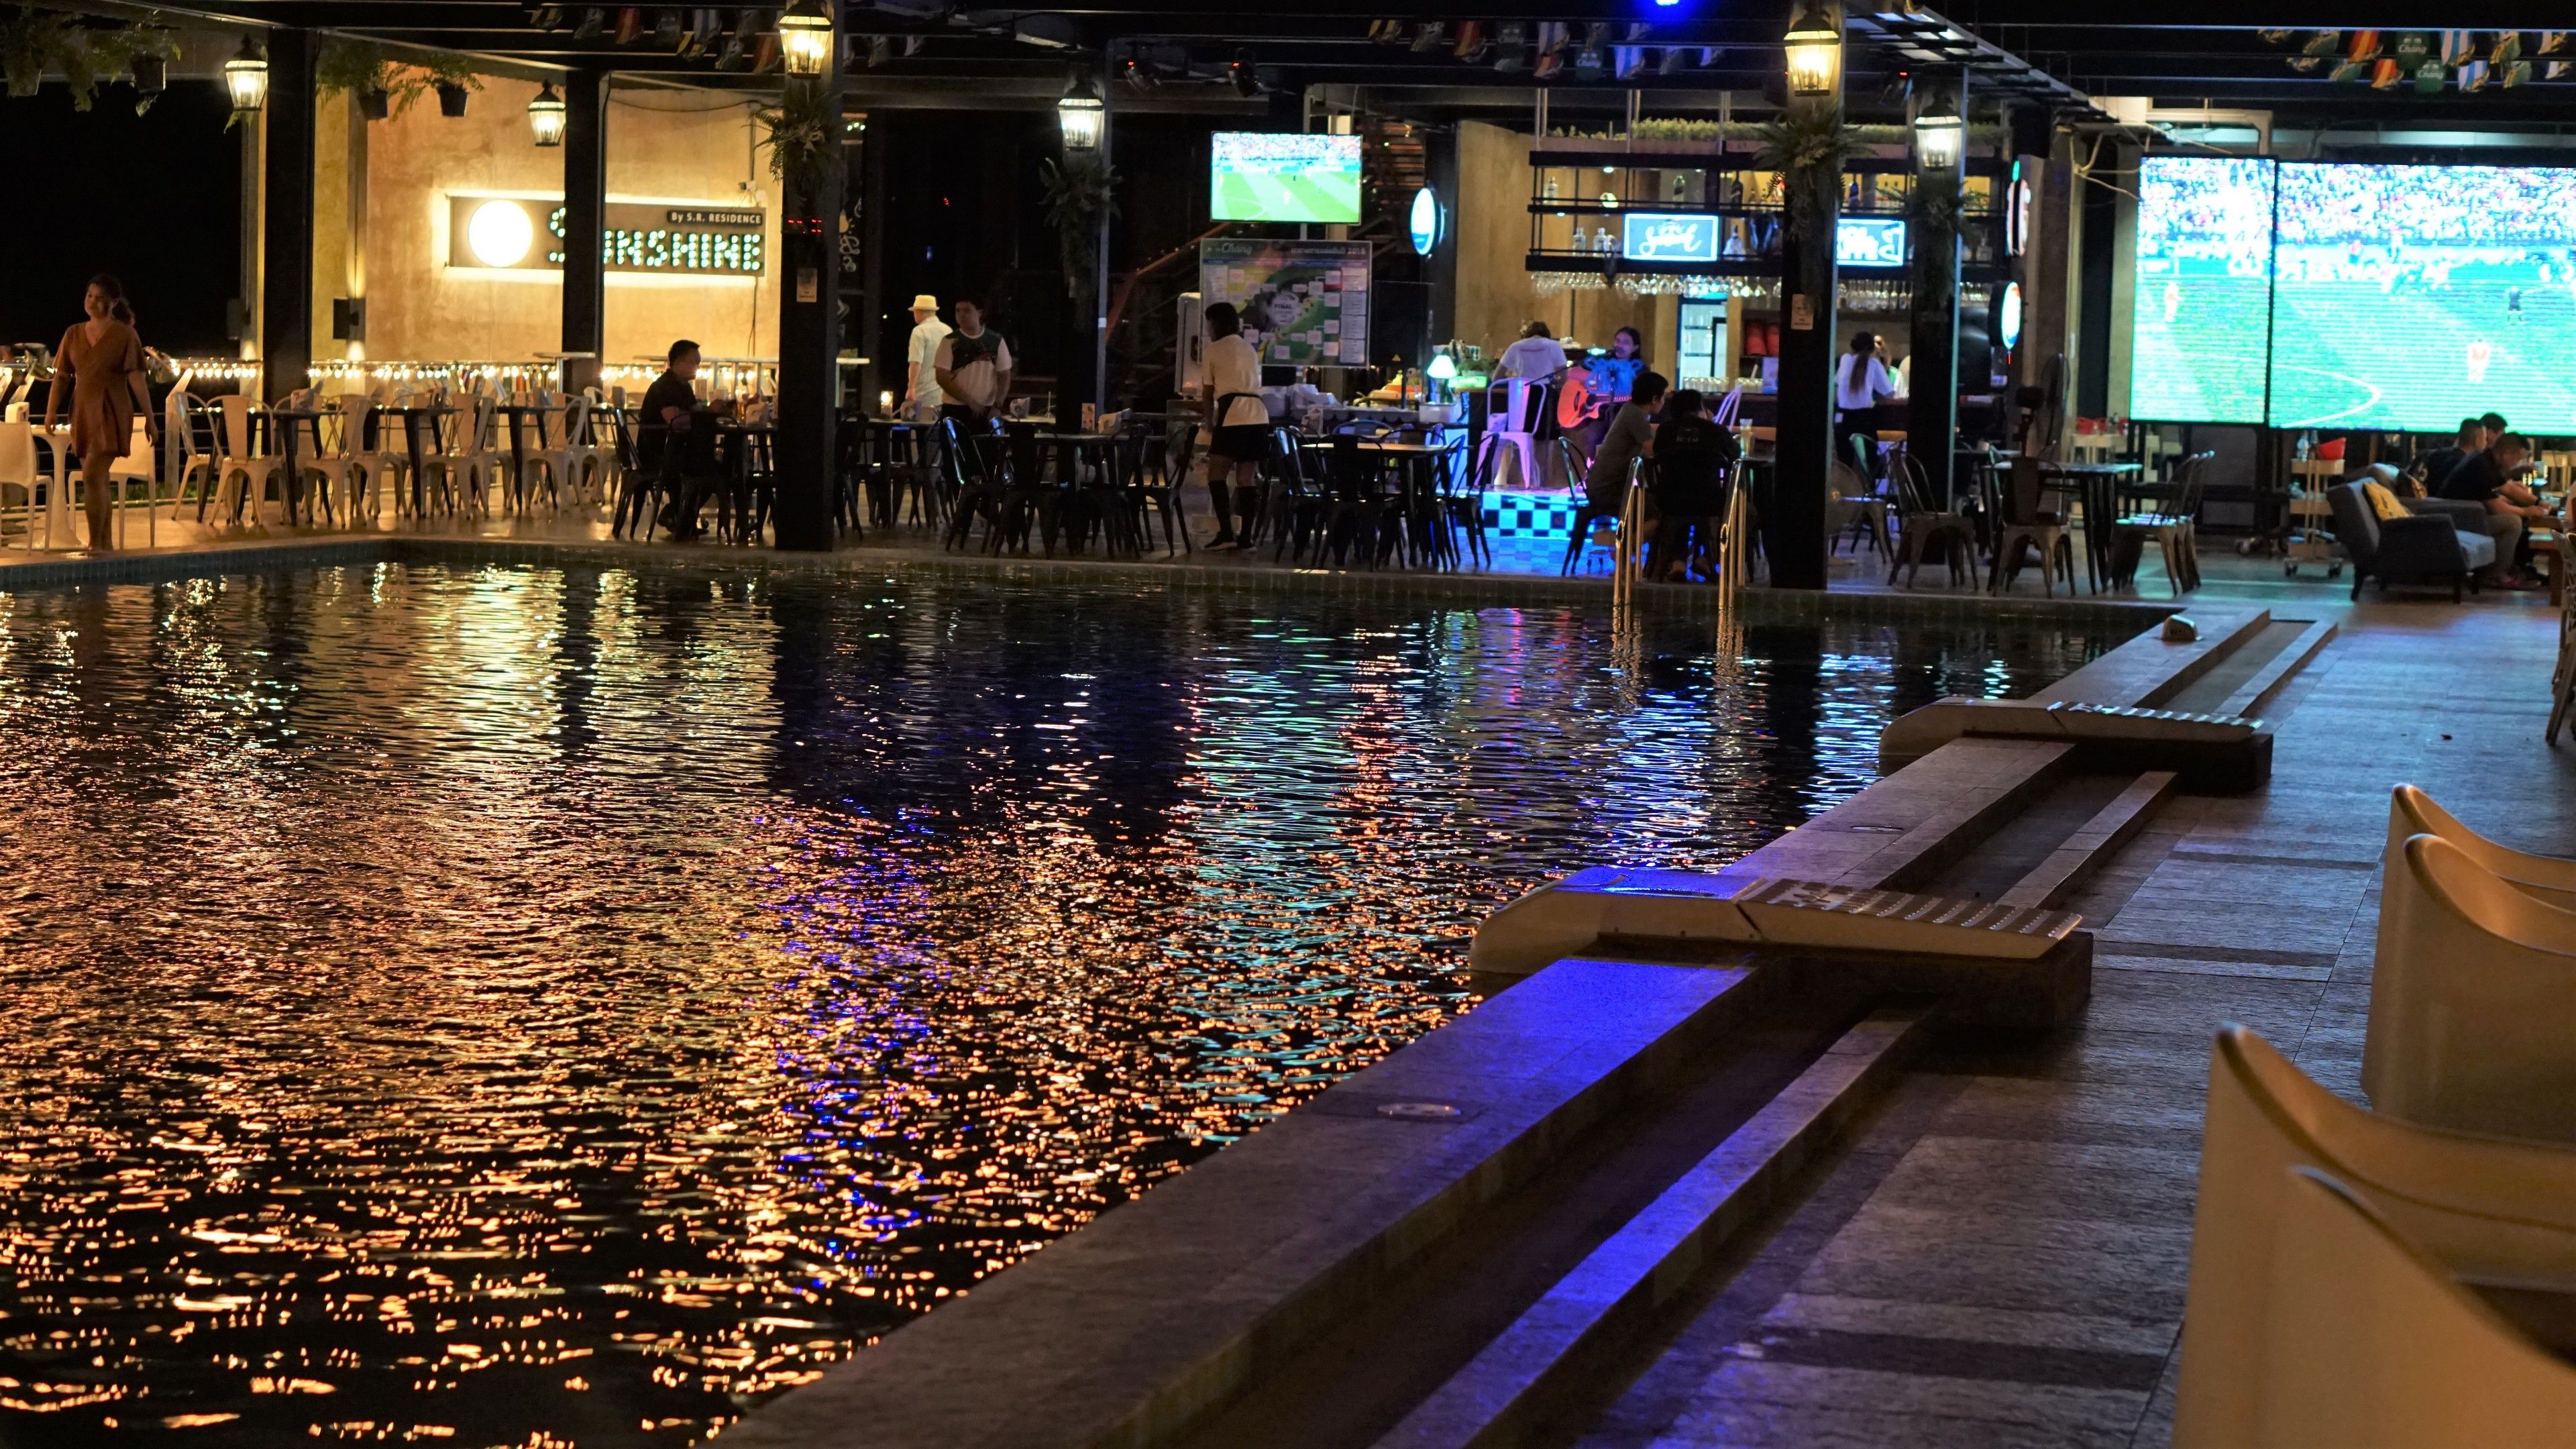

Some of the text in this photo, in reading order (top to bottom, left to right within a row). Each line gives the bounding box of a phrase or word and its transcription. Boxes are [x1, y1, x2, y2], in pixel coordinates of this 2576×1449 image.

[672, 212, 761, 224] By S.R. RESIDENCE
[1222, 242, 1252, 255] Chang
